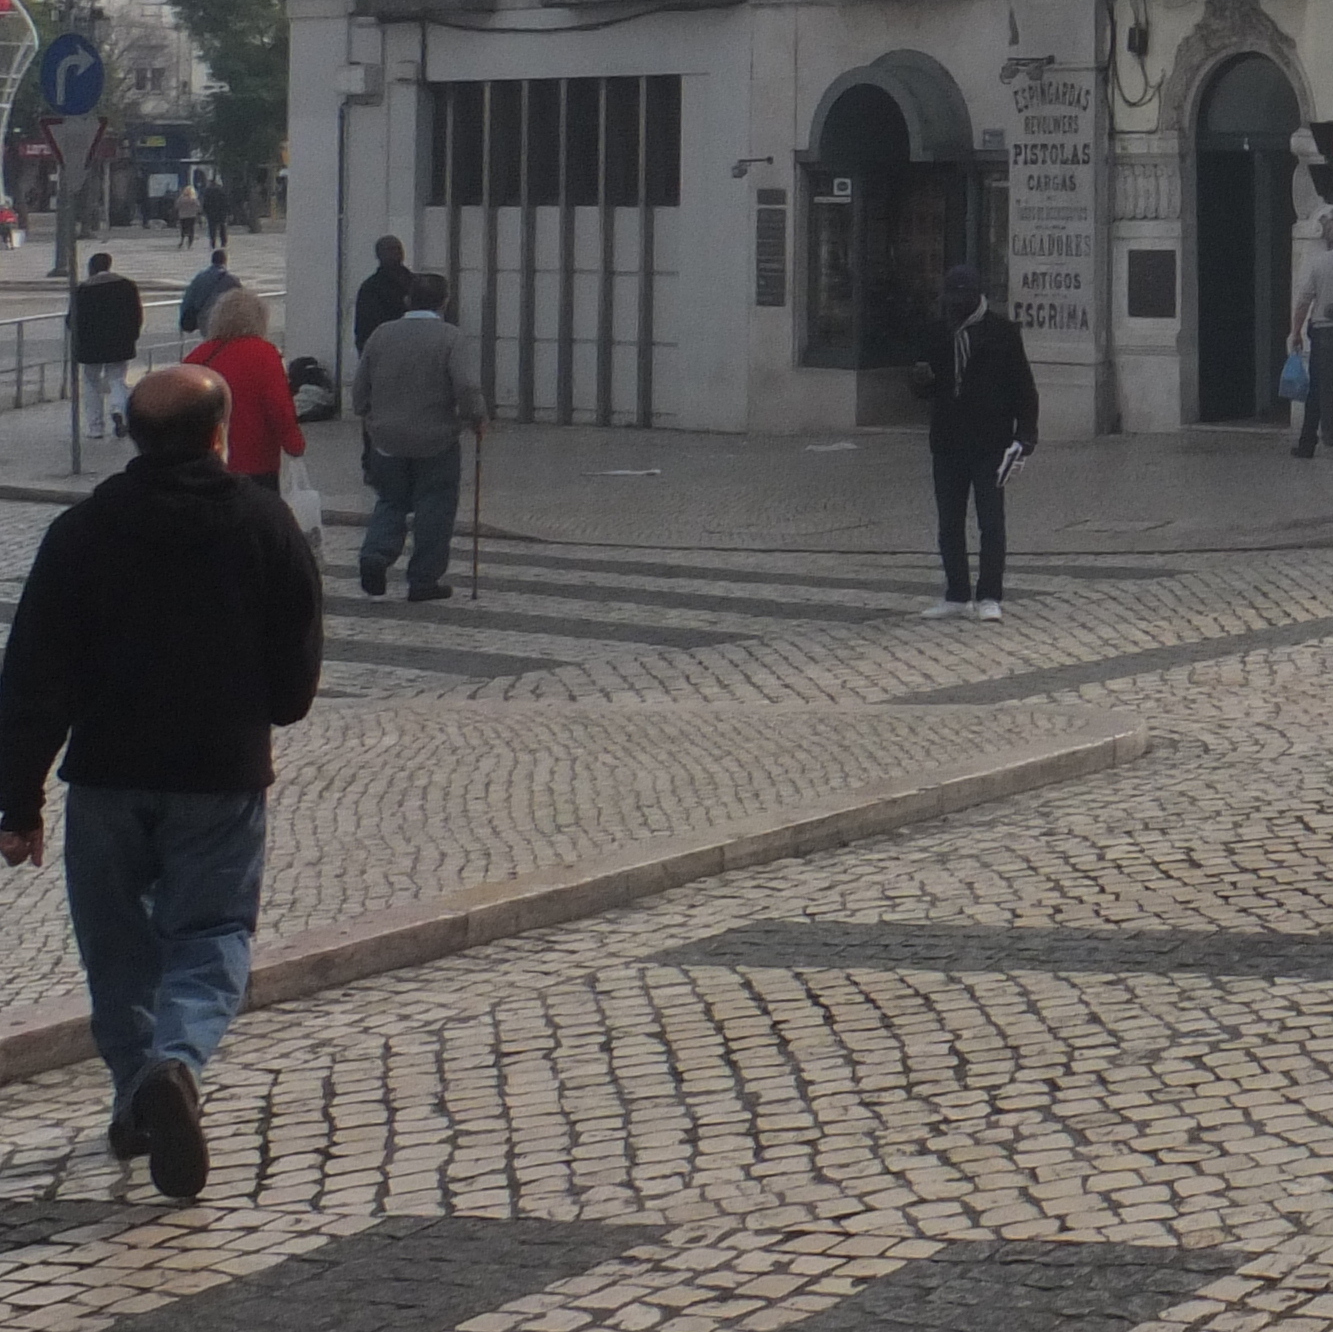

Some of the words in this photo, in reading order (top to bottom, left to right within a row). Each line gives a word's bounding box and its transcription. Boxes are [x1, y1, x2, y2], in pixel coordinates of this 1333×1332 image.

[1013, 81, 1091, 114] ESPINGARDAS
[1013, 143, 1091, 166] PISTOLAS
[1027, 174, 1077, 192] CARGAS
[1022, 271, 1082, 290] ARTIGOS
[1014, 302, 1090, 331] ESGRIMA
